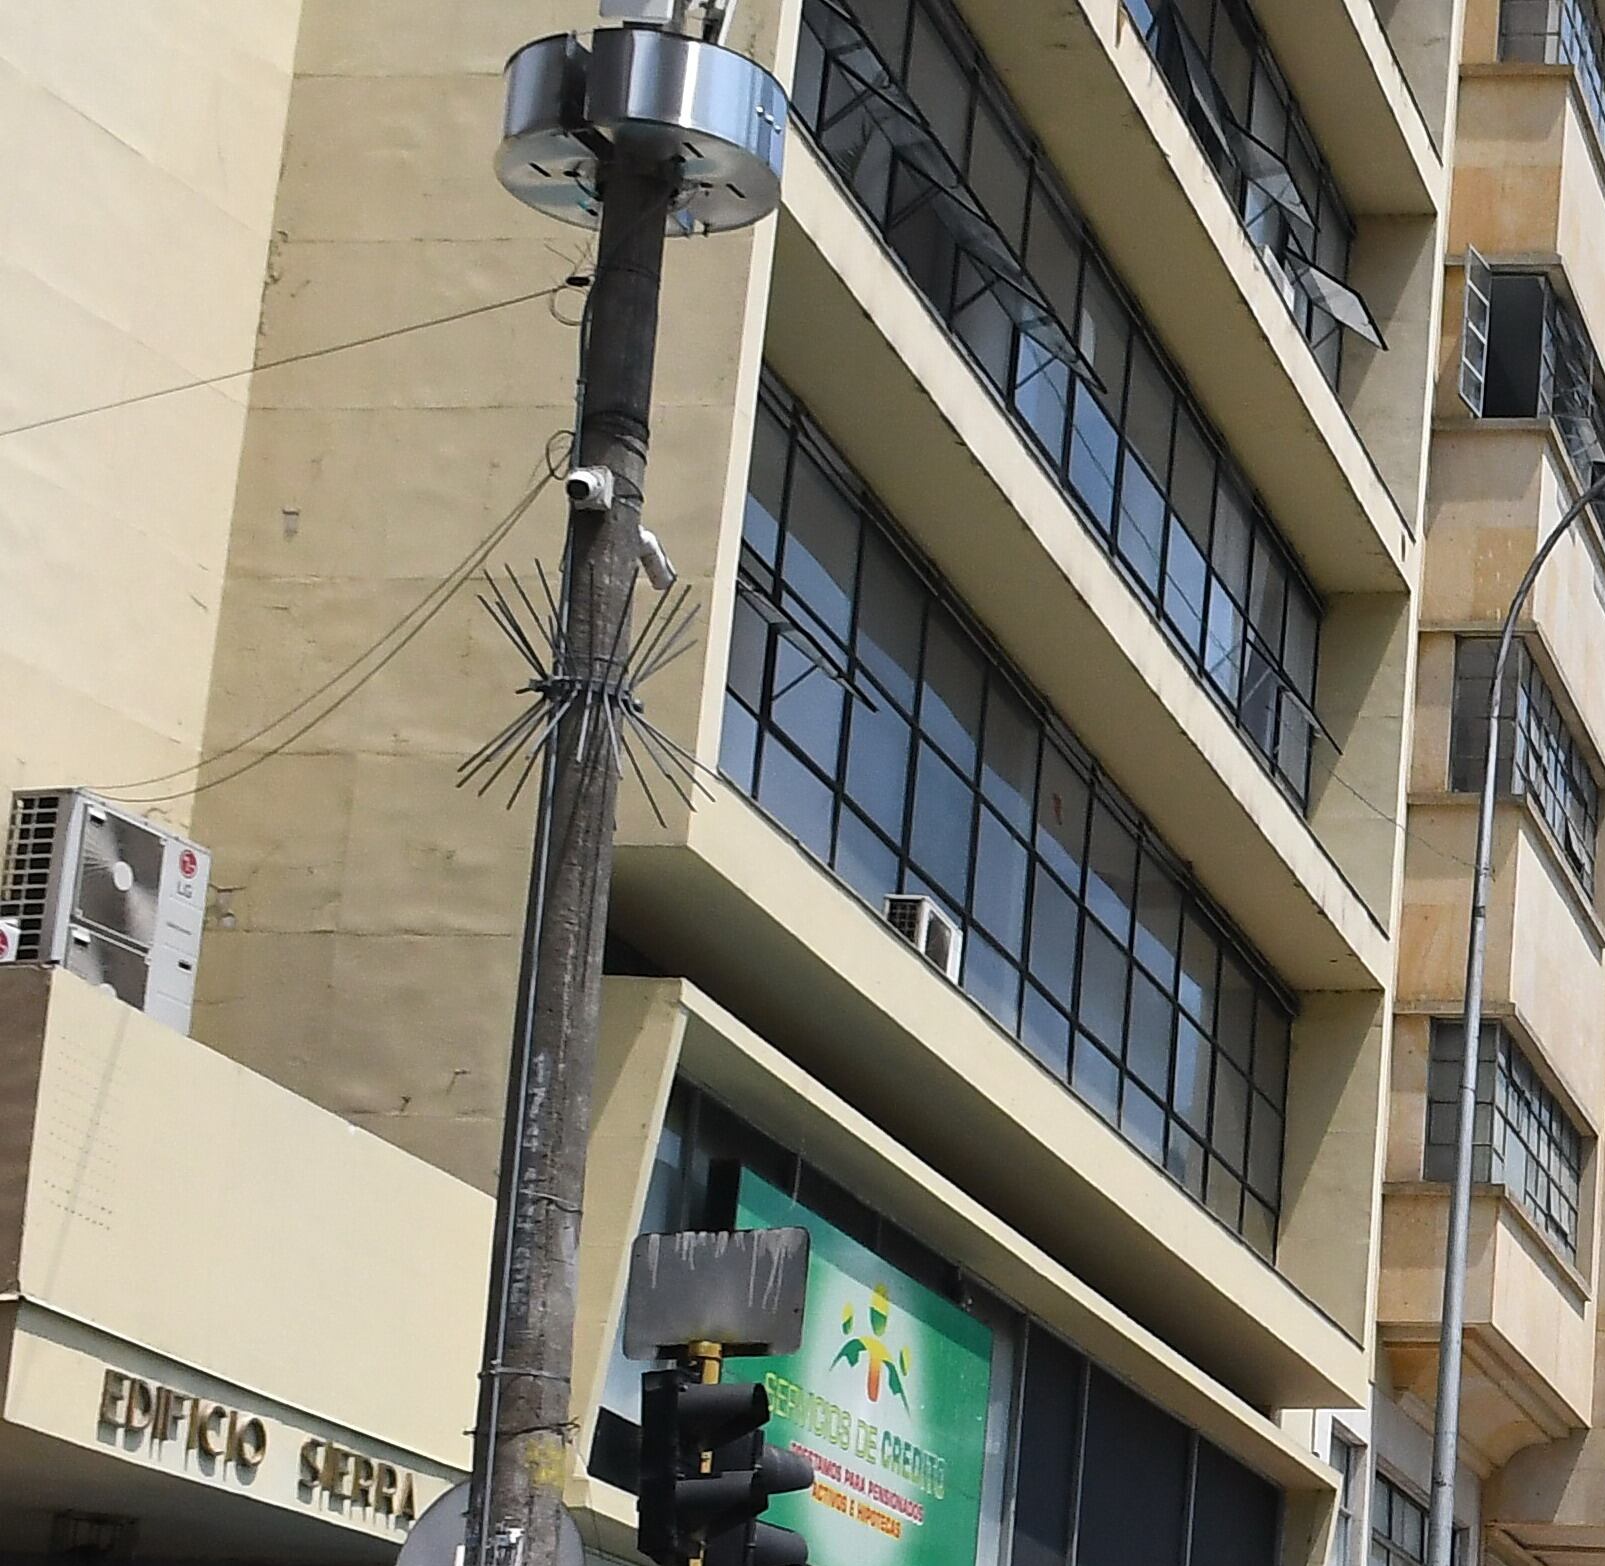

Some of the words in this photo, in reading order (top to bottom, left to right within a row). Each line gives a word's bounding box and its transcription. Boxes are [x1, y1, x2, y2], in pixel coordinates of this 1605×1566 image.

[100, 1368, 268, 1467] EDIFICIO
[298, 1438, 416, 1522] SIERRA
[766, 1372, 851, 1452] SERVICIOS
[855, 1418, 878, 1465] DE
[881, 1430, 946, 1500] CREDITO
[844, 1467, 865, 1493] PARA
[867, 1479, 925, 1525] PENSIONADOS
